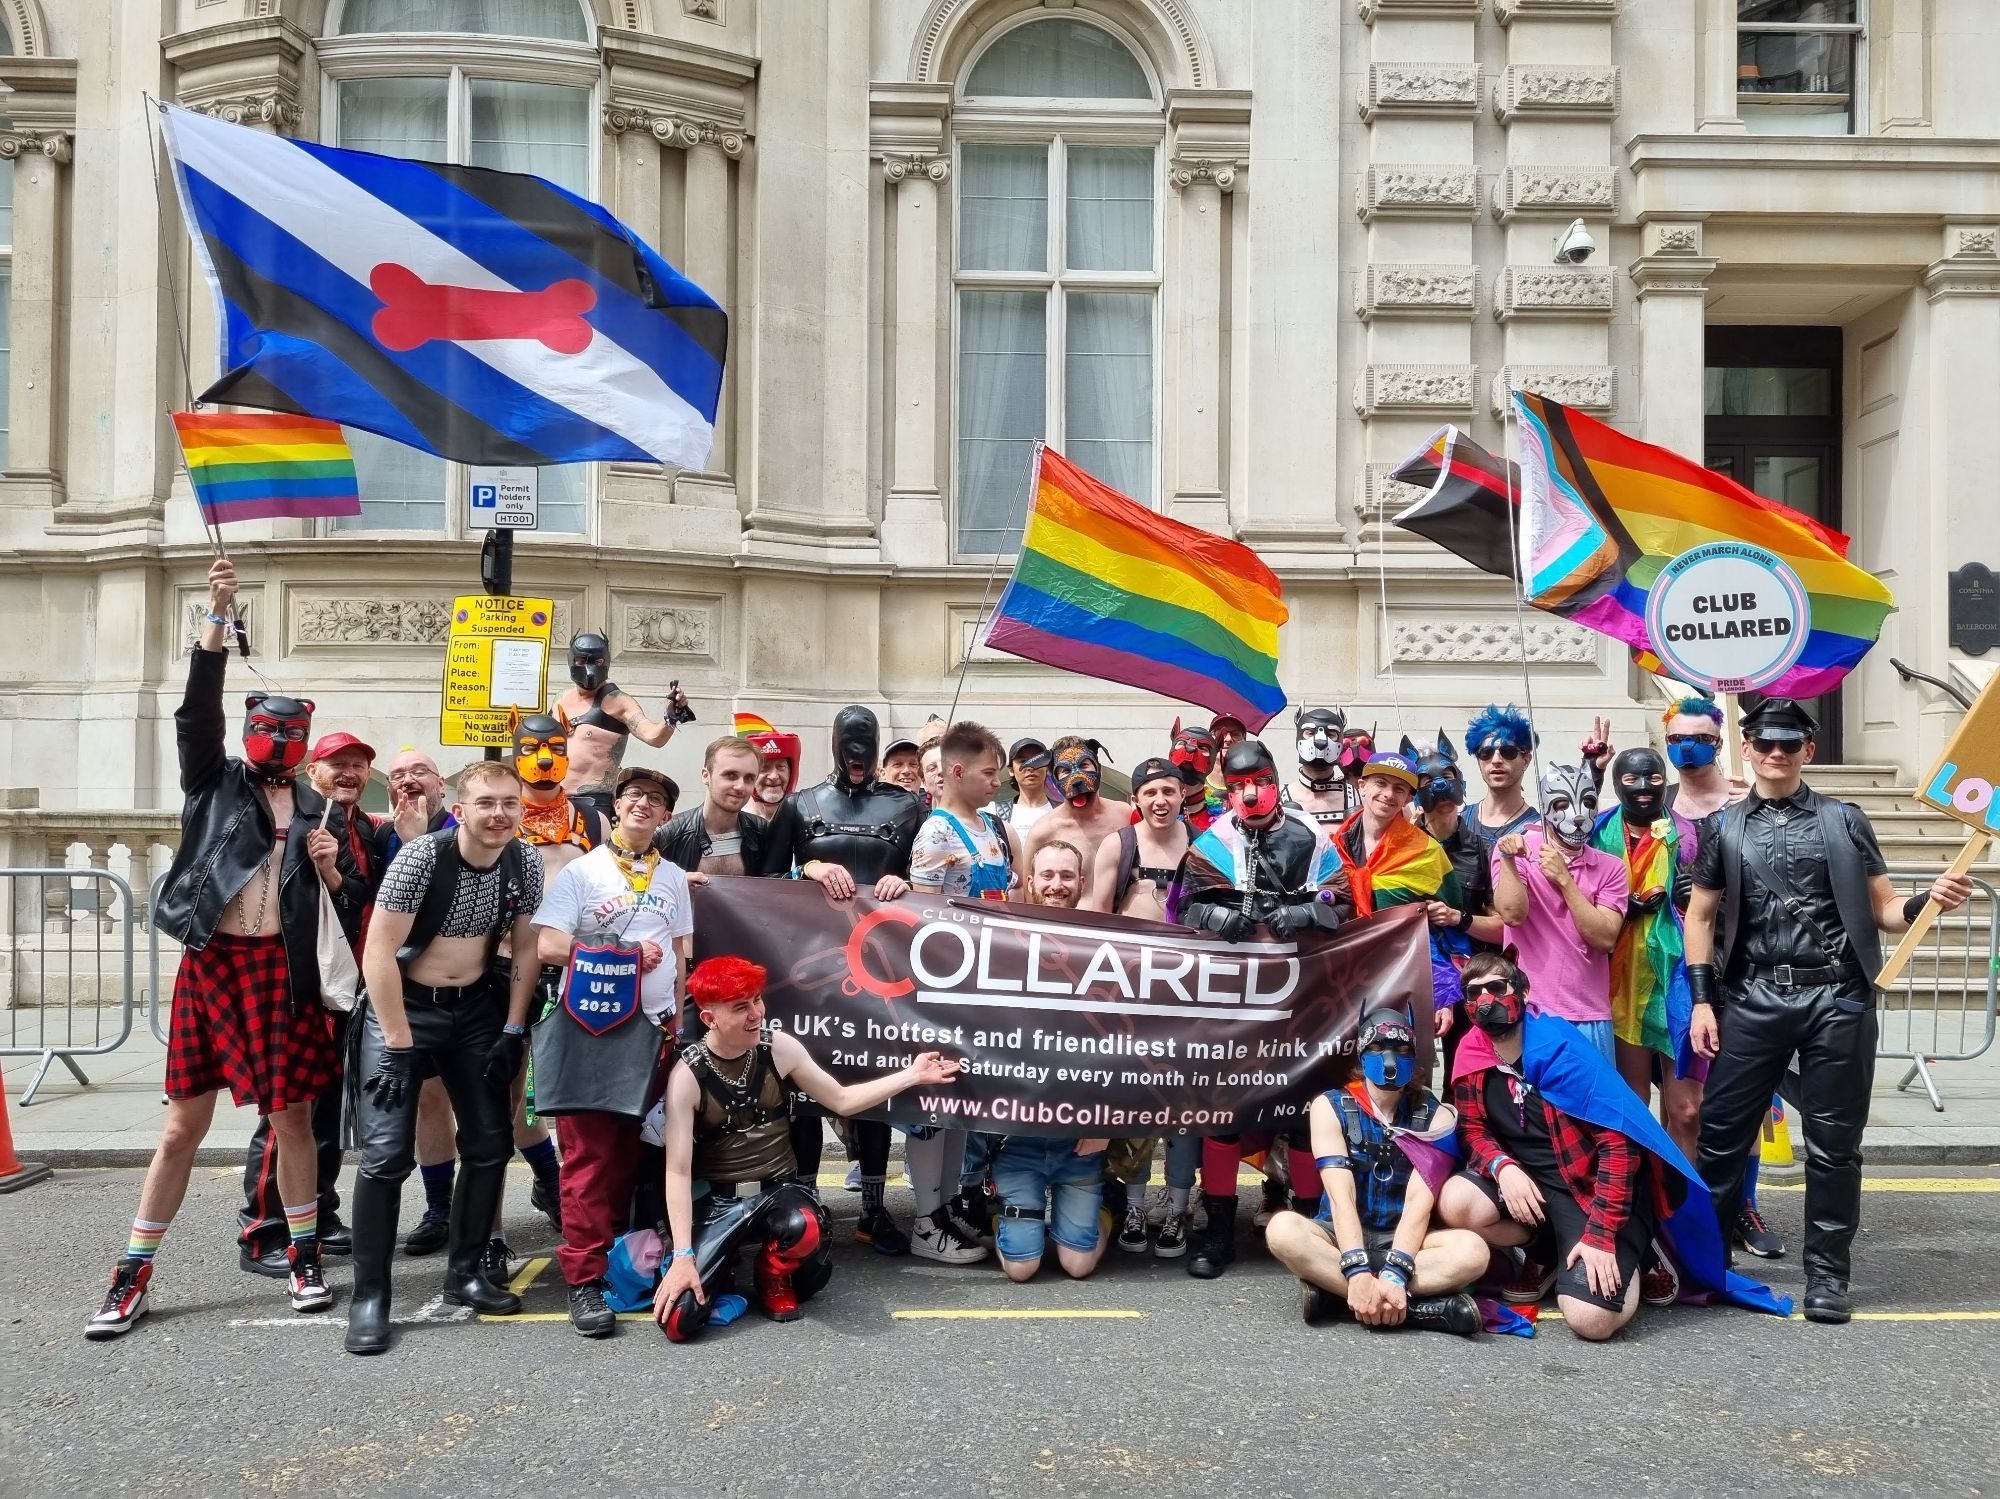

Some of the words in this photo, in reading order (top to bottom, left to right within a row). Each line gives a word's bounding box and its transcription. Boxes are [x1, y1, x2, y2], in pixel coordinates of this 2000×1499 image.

[501, 484, 530, 492] Permit
[478, 487, 493, 506] P
[499, 493, 531, 501] holders
[500, 515, 529, 523] HT001
[1671, 552, 1702, 574] NEVER
[1701, 546, 1739, 558] MARCH
[1739, 547, 1774, 567] ALONE
[474, 599, 525, 610] NOTICE
[1692, 592, 1757, 614] CLUB
[479, 612, 517, 624] Parking
[471, 624, 525, 634] Suspended
[1665, 617, 1791, 642] COLLARED
[453, 640, 480, 650] From:
[452, 654, 478, 664] Until:
[450, 668, 480, 677] Place:
[450, 682, 489, 691] Reason:
[1717, 679, 1745, 687] PRIDE
[449, 696, 469, 705] Ref:
[464, 721, 480, 730] No
[482, 721, 508, 731] waiti
[464, 733, 479, 742] No
[406, 857, 427, 869] BOYS
[402, 865, 422, 876] BOYS
[399, 873, 419, 884] BOYS
[460, 878, 479, 888] BOYS
[395, 881, 416, 891] BOYS
[459, 884, 478, 896] BOYS
[478, 879, 495, 890] BOYS
[392, 889, 413, 899] BOYS
[458, 892, 477, 904] BOYS
[477, 886, 494, 898] BOYS
[455, 900, 475, 911] BOYS
[476, 894, 494, 905] BOYS
[453, 908, 473, 919] BOYS
[474, 902, 493, 913] BOYS
[922, 908, 980, 924] CLUB
[450, 915, 471, 926] BOYS
[472, 909, 492, 920] BOYS
[600, 908, 629, 929] Together
[842, 905, 1300, 1005] COLLARED
[575, 959, 637, 976] TRAINER
[589, 980, 616, 994] UK
[578, 998, 621, 1013] 2023
[793, 1014, 856, 1037] UK's
[867, 1018, 963, 1044] hottest
[973, 1027, 1022, 1049] and
[1032, 1029, 1177, 1058] friendliest
[1186, 1039, 1248, 1060] male
[1256, 1037, 1308, 1058] kink
[831, 1050, 869, 1067] 2nd
[876, 1053, 912, 1069] and
[959, 1057, 1050, 1084] Saturday
[1056, 1067, 1114, 1087] every
[1121, 1070, 1185, 1087] month
[1191, 1071, 1210, 1086] in
[1216, 1071, 1288, 1086] London
[919, 1094, 1235, 1126] www.ClubCollared.com
[1273, 1103, 1296, 1118] No
